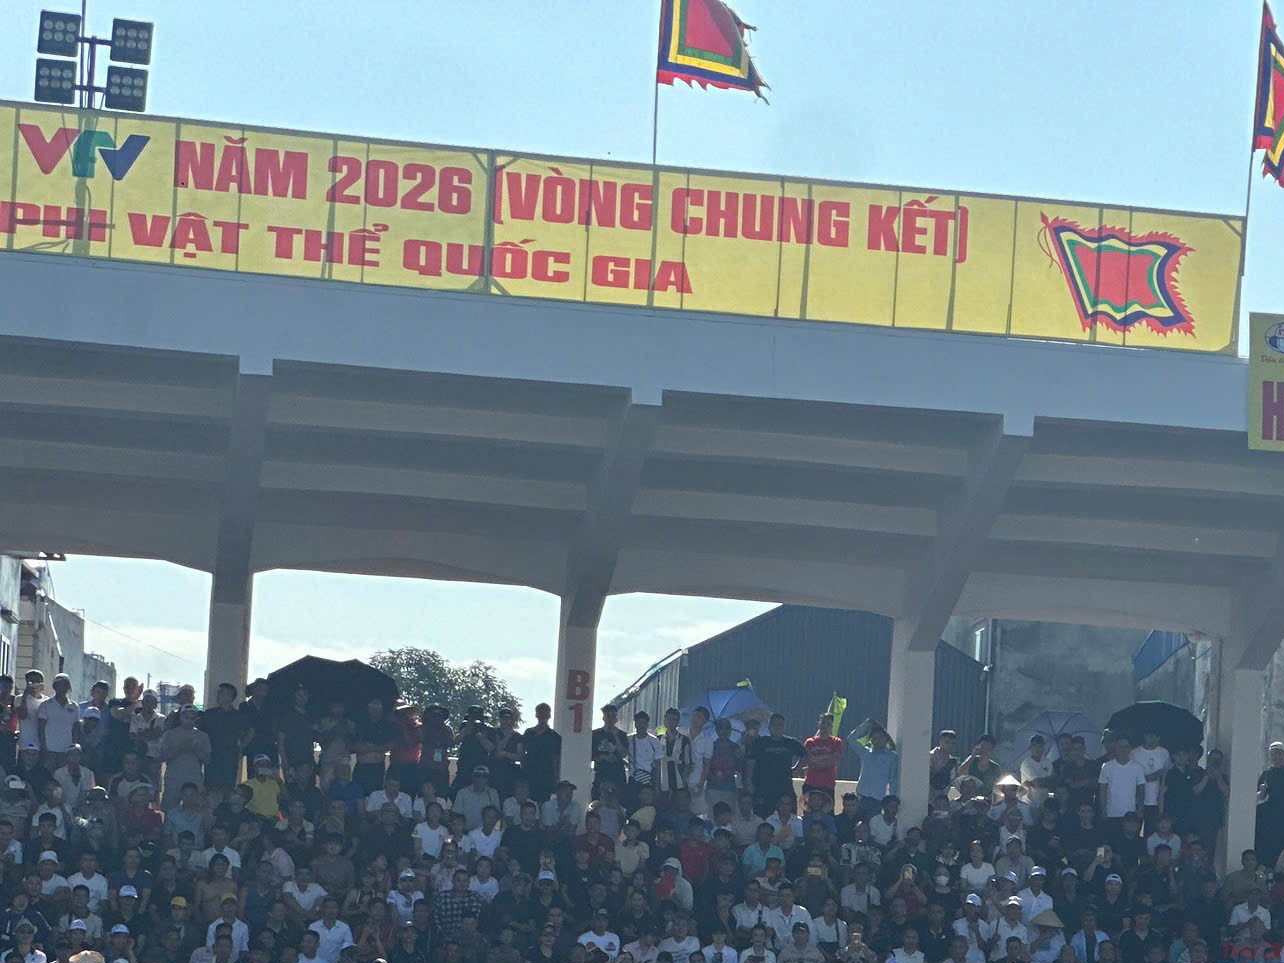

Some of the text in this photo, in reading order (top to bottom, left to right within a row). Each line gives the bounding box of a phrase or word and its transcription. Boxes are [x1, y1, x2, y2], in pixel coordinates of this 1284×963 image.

[18, 123, 151, 181] VTV
[175, 135, 309, 200] NĂM
[325, 155, 473, 215] 2026
[670, 187, 851, 250] CHUNG
[0, 200, 693, 294] PHI VẬT THỂ QUỐC GIA
